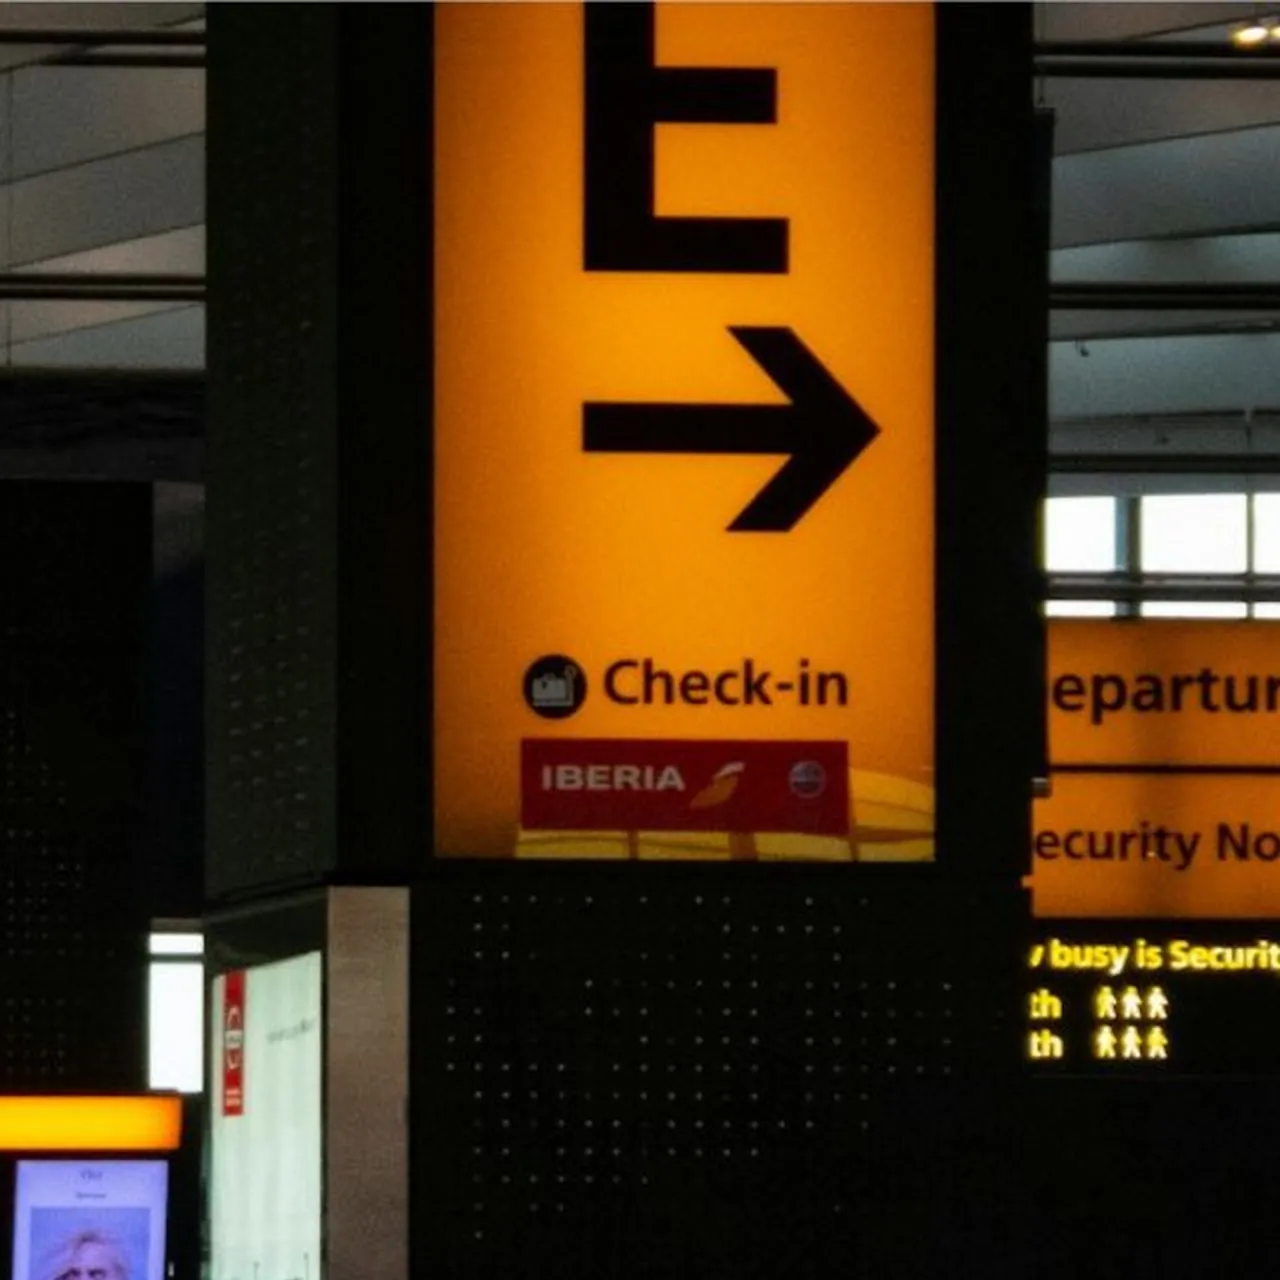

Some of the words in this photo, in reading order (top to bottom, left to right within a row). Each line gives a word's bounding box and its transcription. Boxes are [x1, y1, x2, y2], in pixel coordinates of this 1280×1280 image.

[582, 0, 789, 274] E
[603, 658, 849, 706] Check-in
[543, 764, 686, 792] IBERIA
[1036, 822, 1202, 872] ecurity
[1050, 938, 1130, 975] busy
[1136, 939, 1164, 970] is
